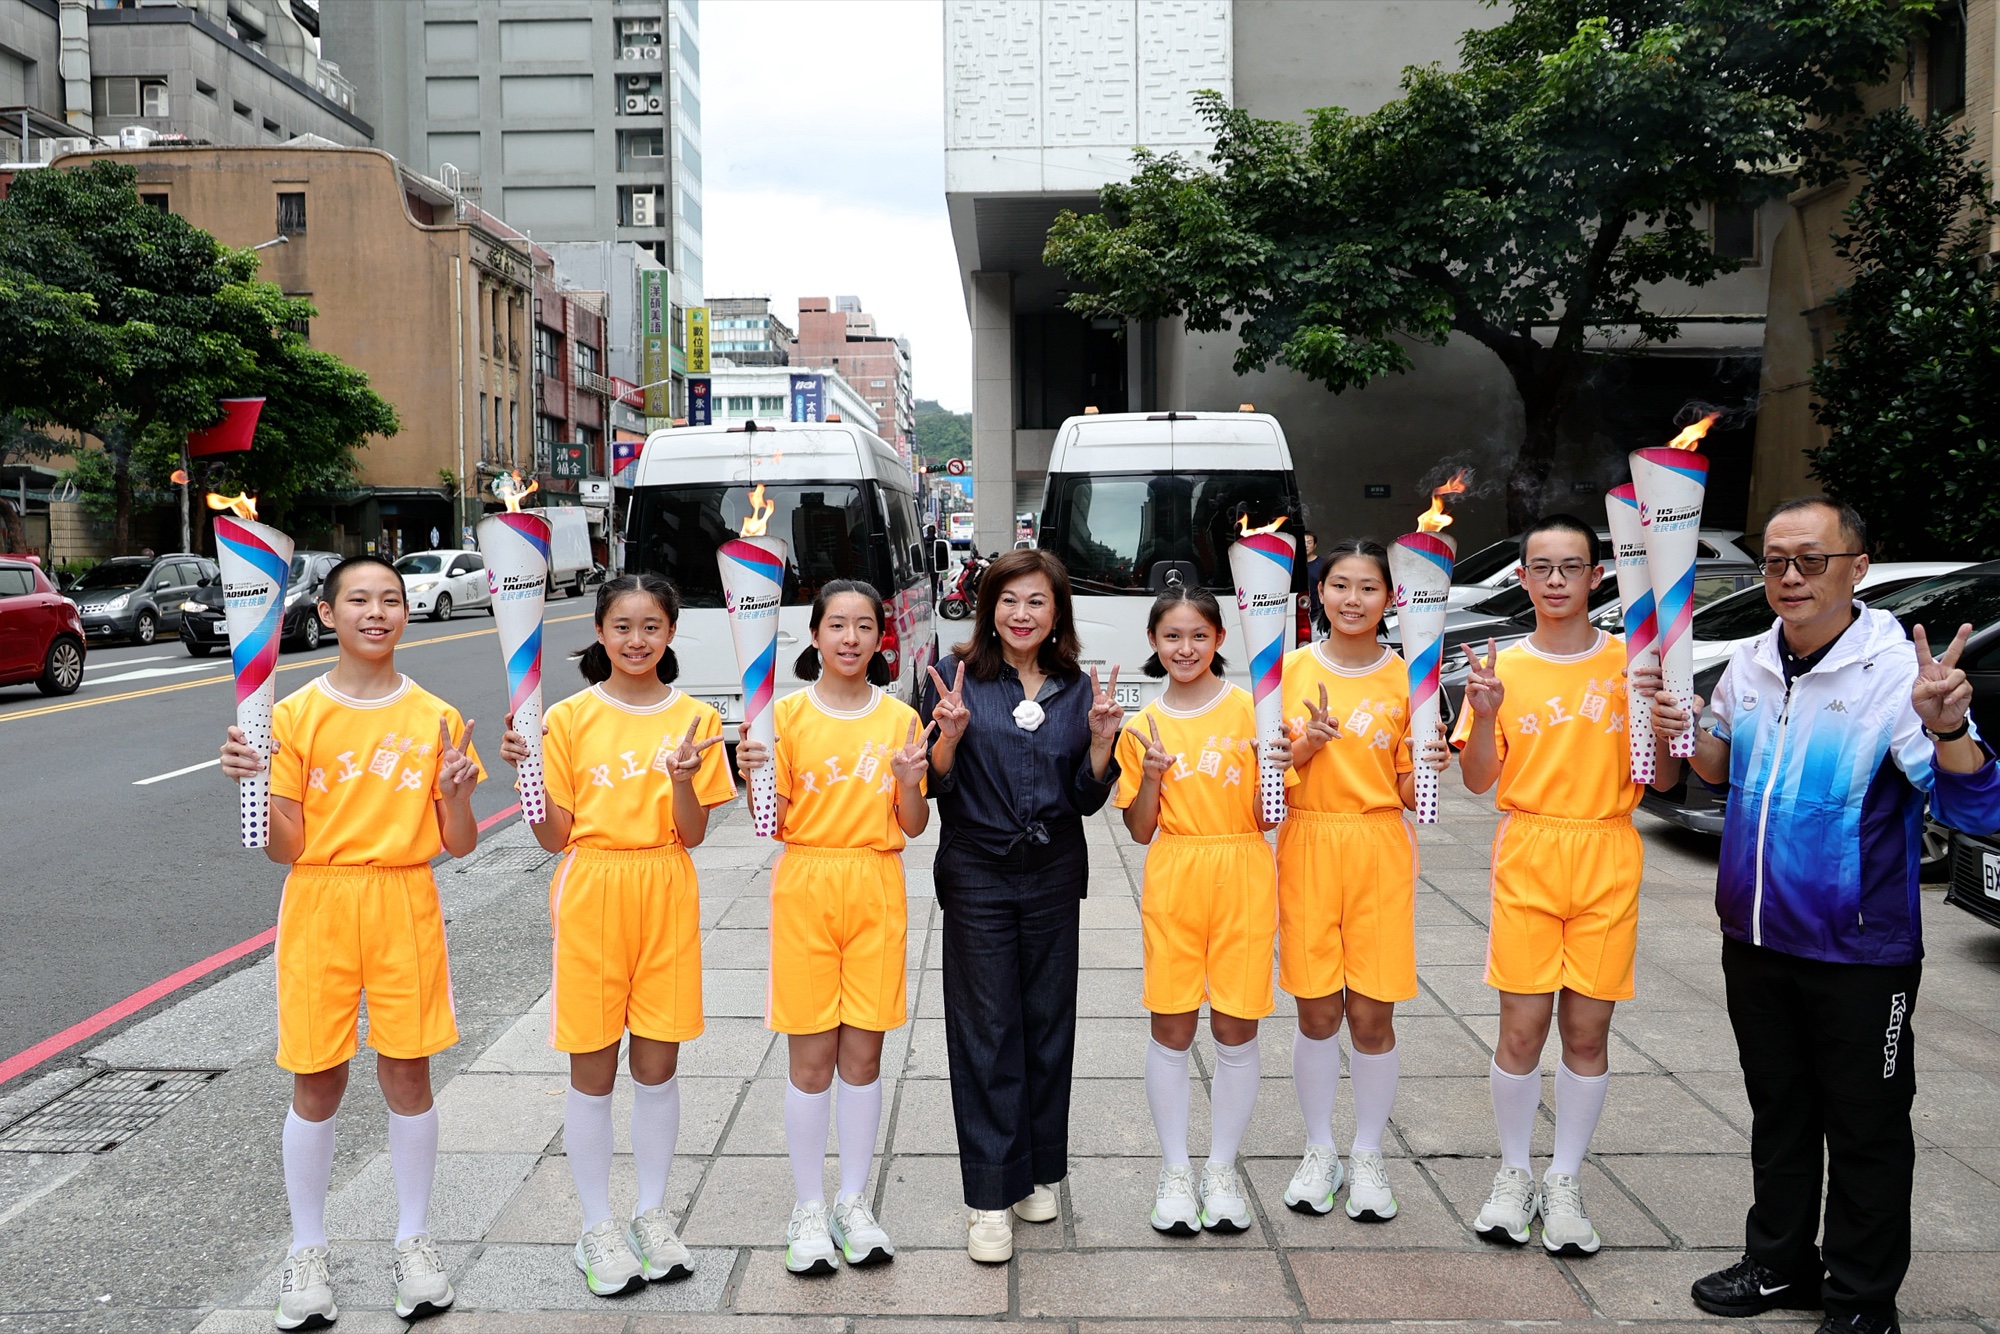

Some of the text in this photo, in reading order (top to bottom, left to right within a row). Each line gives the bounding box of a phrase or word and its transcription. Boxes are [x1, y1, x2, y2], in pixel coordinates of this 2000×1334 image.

[649, 285, 661, 333] 洋碩美語
[693, 326, 704, 370] 數位學堂
[695, 398, 705, 426] 永豐
[1656, 509, 1701, 522] TAOYUAN
[1653, 517, 1699, 533] 全民運在桃園
[1618, 557, 1648, 567] 全民運在
[503, 579, 544, 591] TAOYUAN
[504, 575, 519, 583] 115
[224, 587, 268, 598] TAOYUAN
[500, 587, 543, 601] 全民運在桃園
[226, 596, 267, 608] 民運在桃園
[739, 600, 780, 610] TAOYUAN
[1360, 698, 1403, 718] 基隆市
[382, 732, 433, 759] 基隆市
[1206, 735, 1249, 751] 基隆市
[589, 750, 670, 788] 中正國
[1884, 992, 1906, 1079] Kappa
